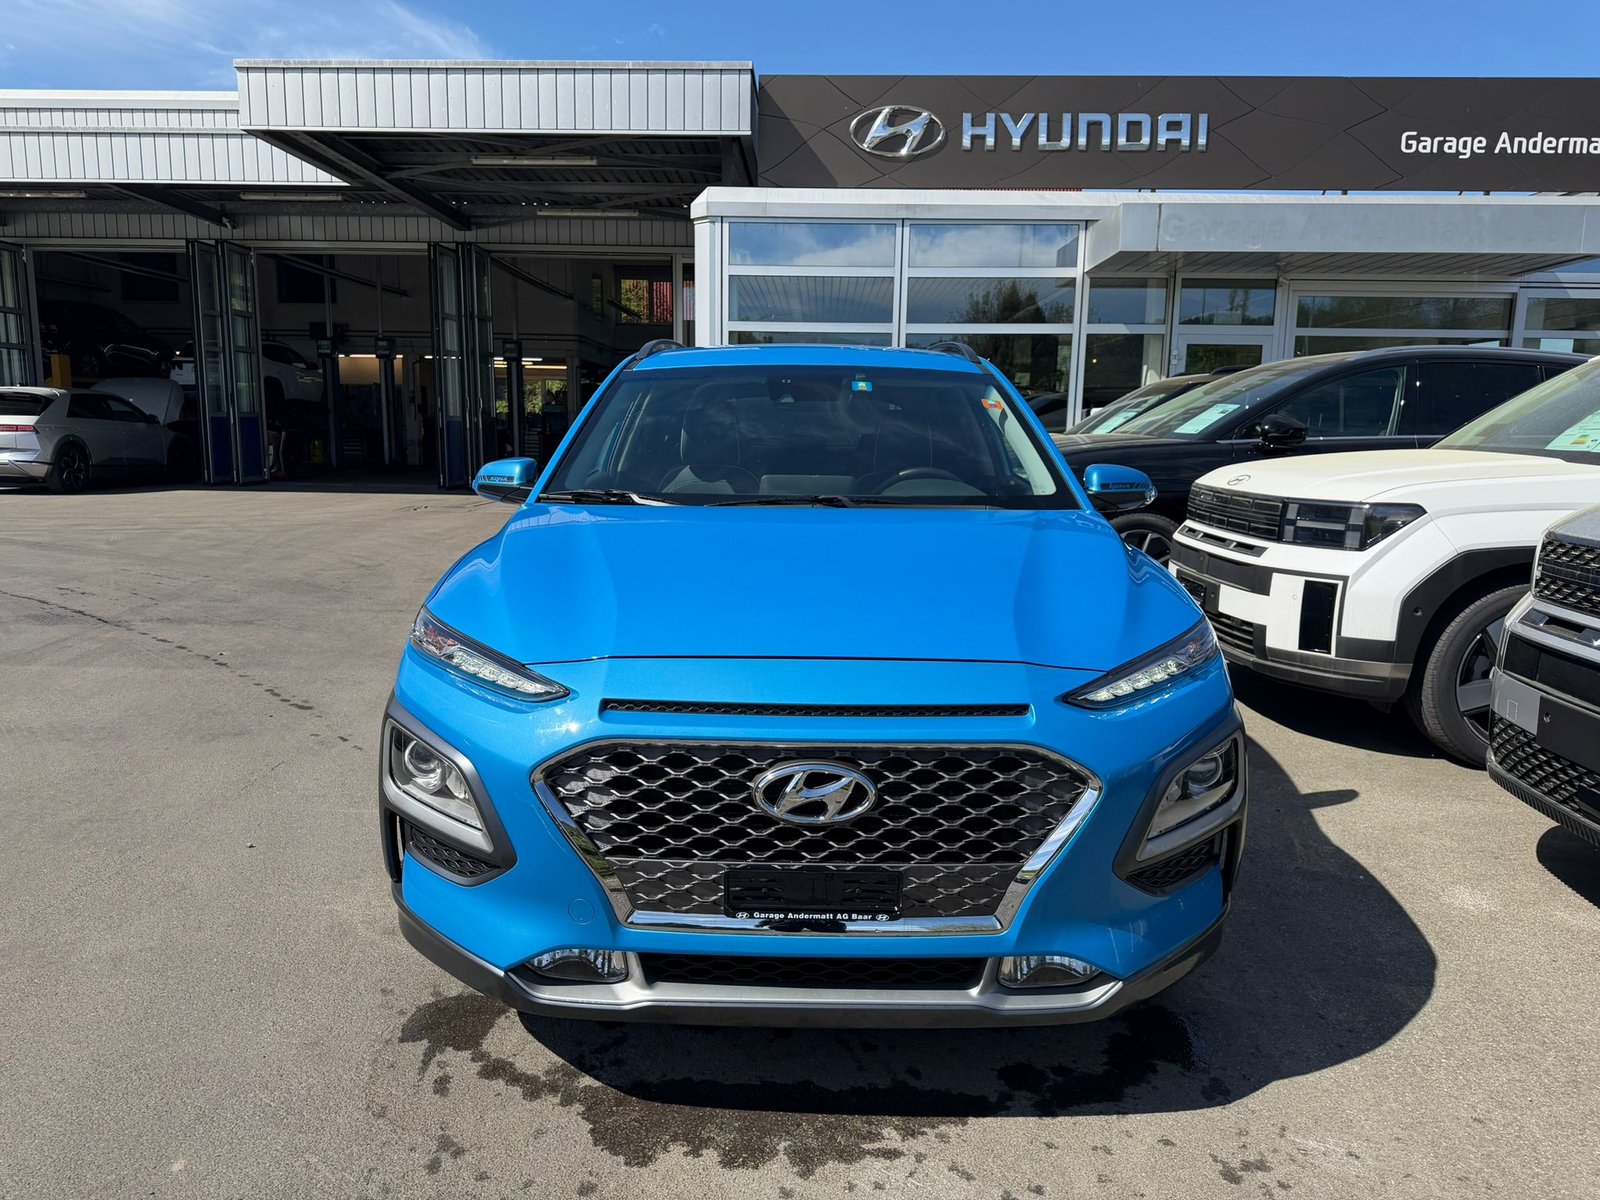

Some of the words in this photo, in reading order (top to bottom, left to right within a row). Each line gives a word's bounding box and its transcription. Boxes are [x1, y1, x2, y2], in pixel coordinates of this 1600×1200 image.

[962, 112, 1208, 151] HYUNDAI
[1400, 131, 1487, 159] Garage
[1494, 131, 1600, 154] Anderma
[753, 911, 785, 919] Garage
[787, 912, 833, 920] Andermatt
